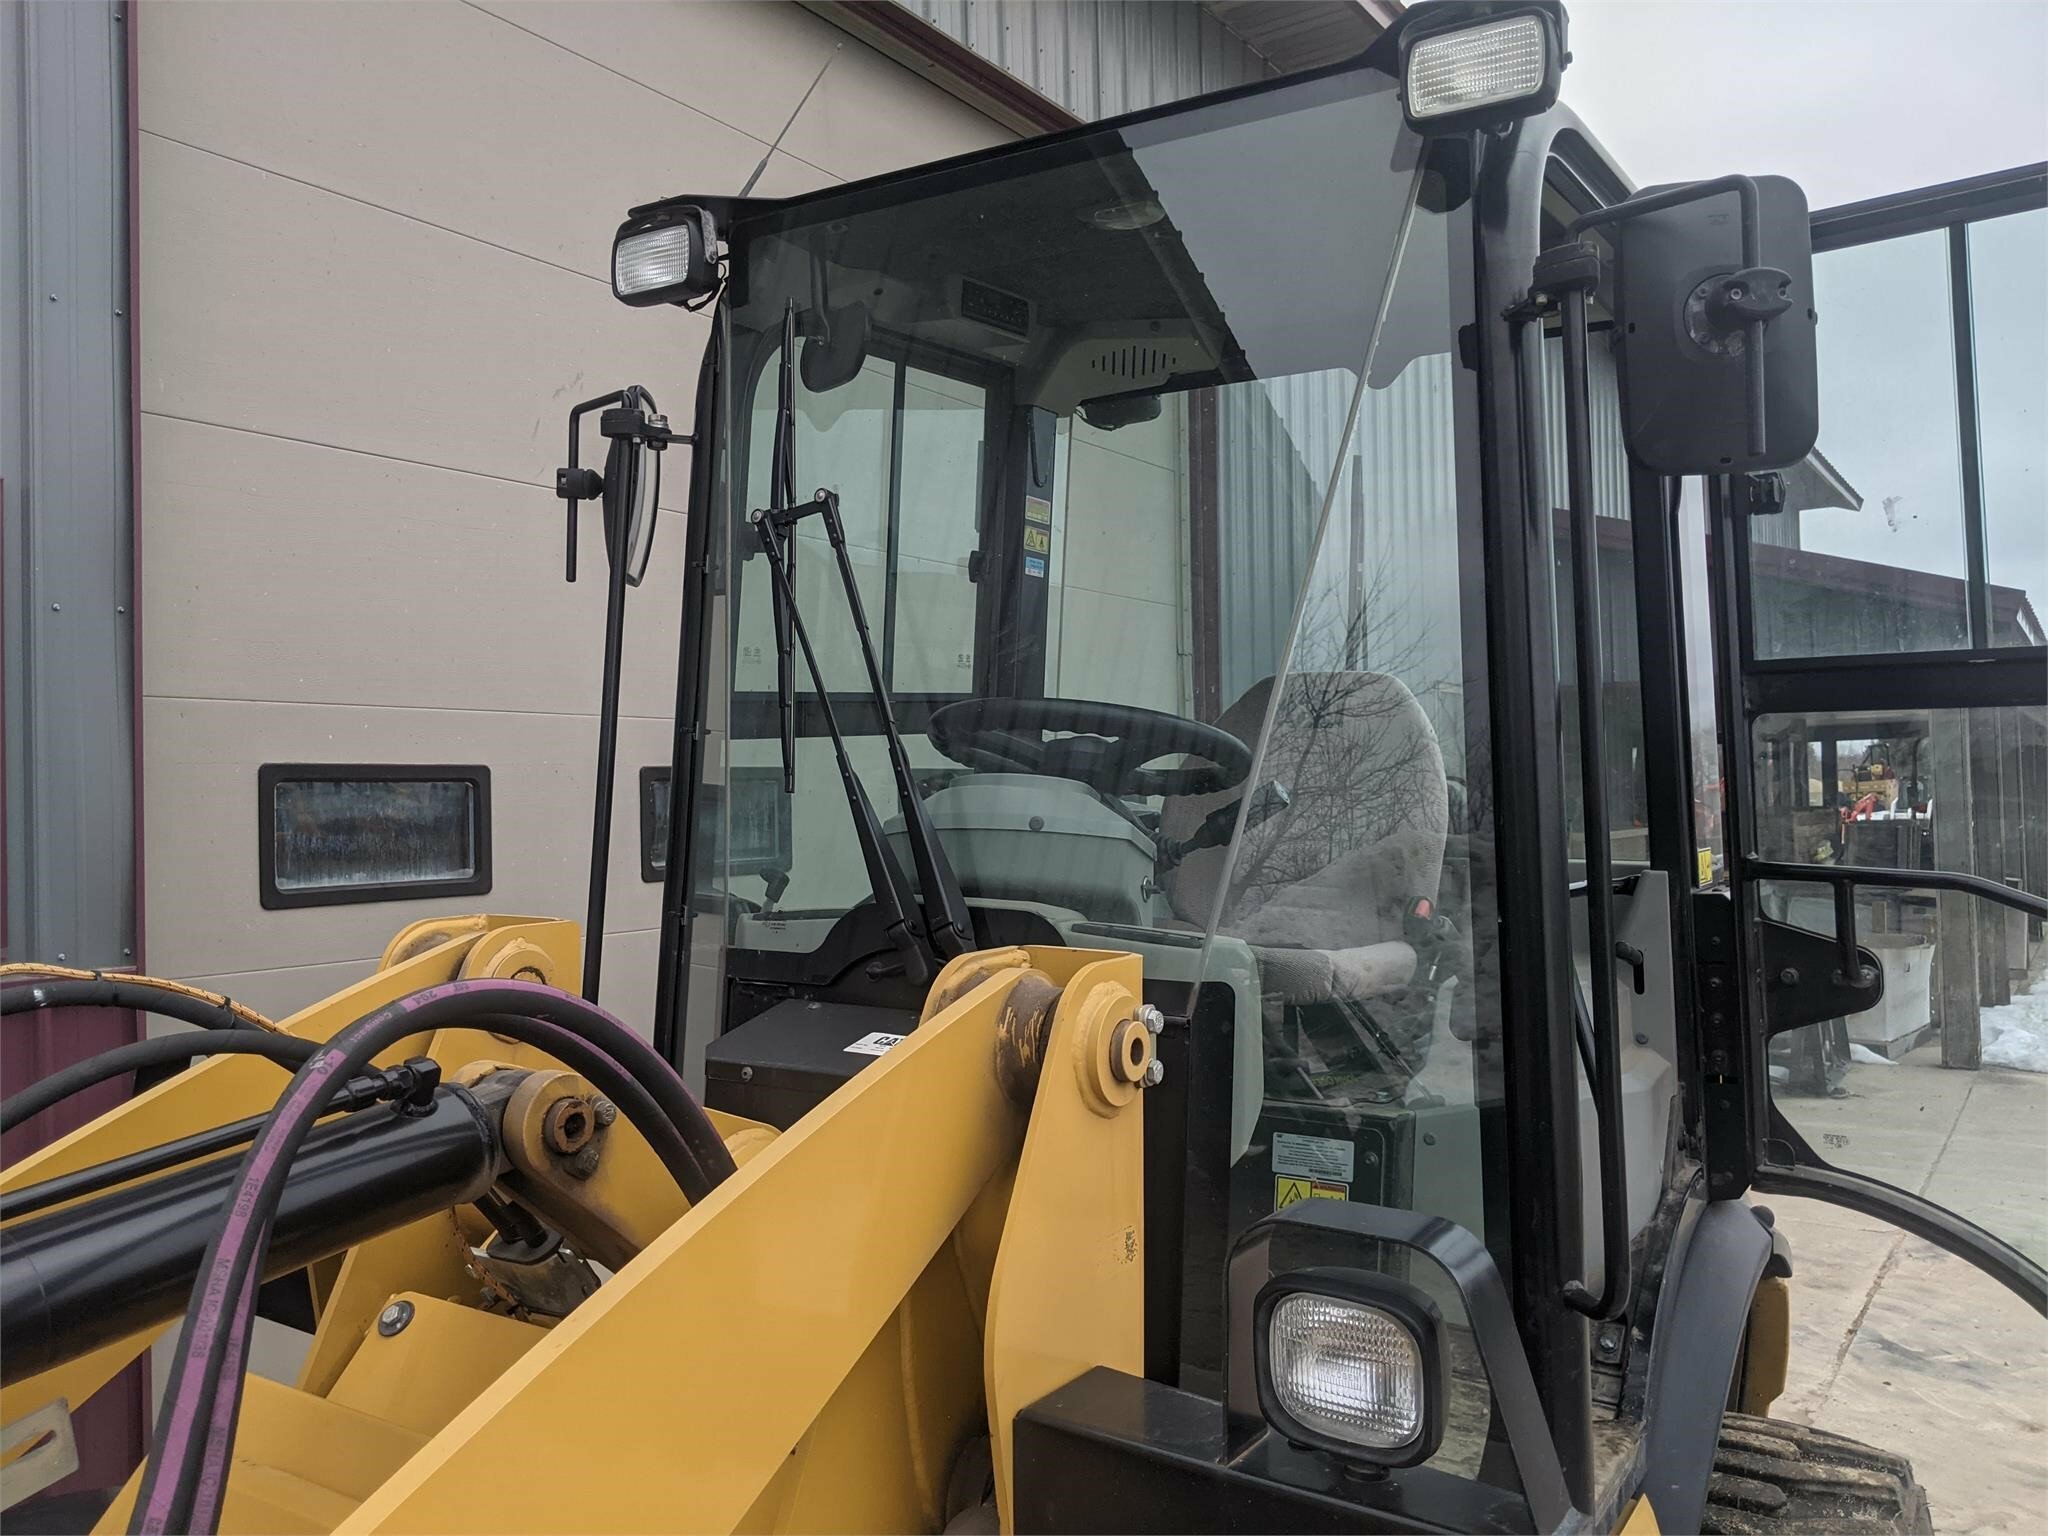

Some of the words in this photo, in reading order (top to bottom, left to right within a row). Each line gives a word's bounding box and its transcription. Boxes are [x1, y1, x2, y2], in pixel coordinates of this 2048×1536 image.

[350, 1011, 393, 1042] Compact
[872, 1036, 904, 1047] CA
[235, 1177, 260, 1218] 1E4198
[210, 1258, 230, 1297] MSHA
